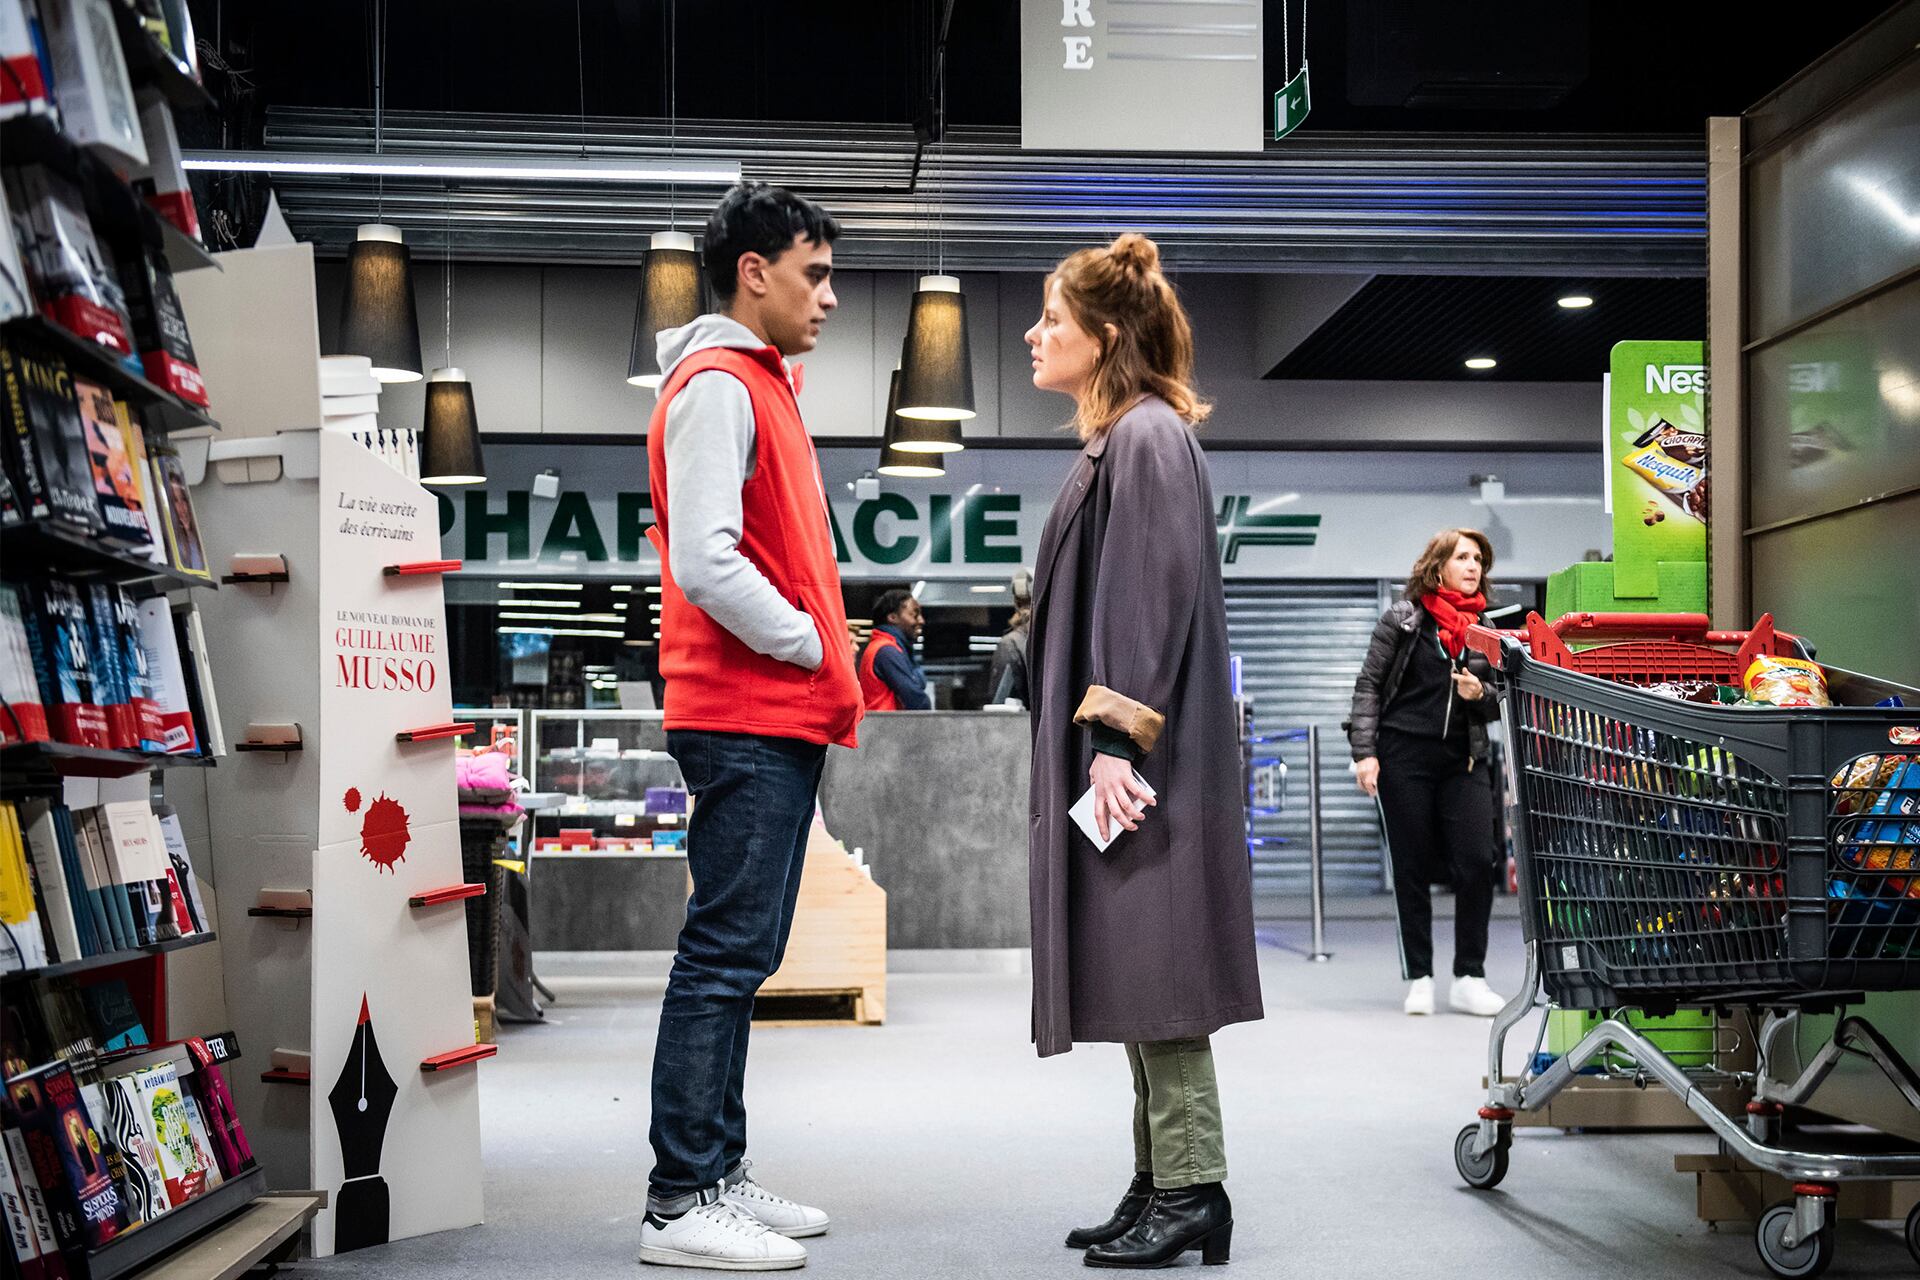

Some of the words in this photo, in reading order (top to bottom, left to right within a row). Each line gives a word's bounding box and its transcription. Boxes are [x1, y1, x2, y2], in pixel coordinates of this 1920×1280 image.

[1637, 455, 1696, 482] Nesquik
[338, 492, 355, 511] La
[359, 496, 377, 512] vie
[379, 501, 418, 518] secrète
[339, 518, 358, 535] des
[360, 522, 414, 542] écrivains
[337, 610, 348, 622] LE
[349, 611, 390, 625] NOUVEAU
[391, 614, 422, 627] ROMAN
[423, 618, 435, 629] DE
[336, 627, 435, 653] GUILLAUME
[336, 654, 436, 693] MUSSO
